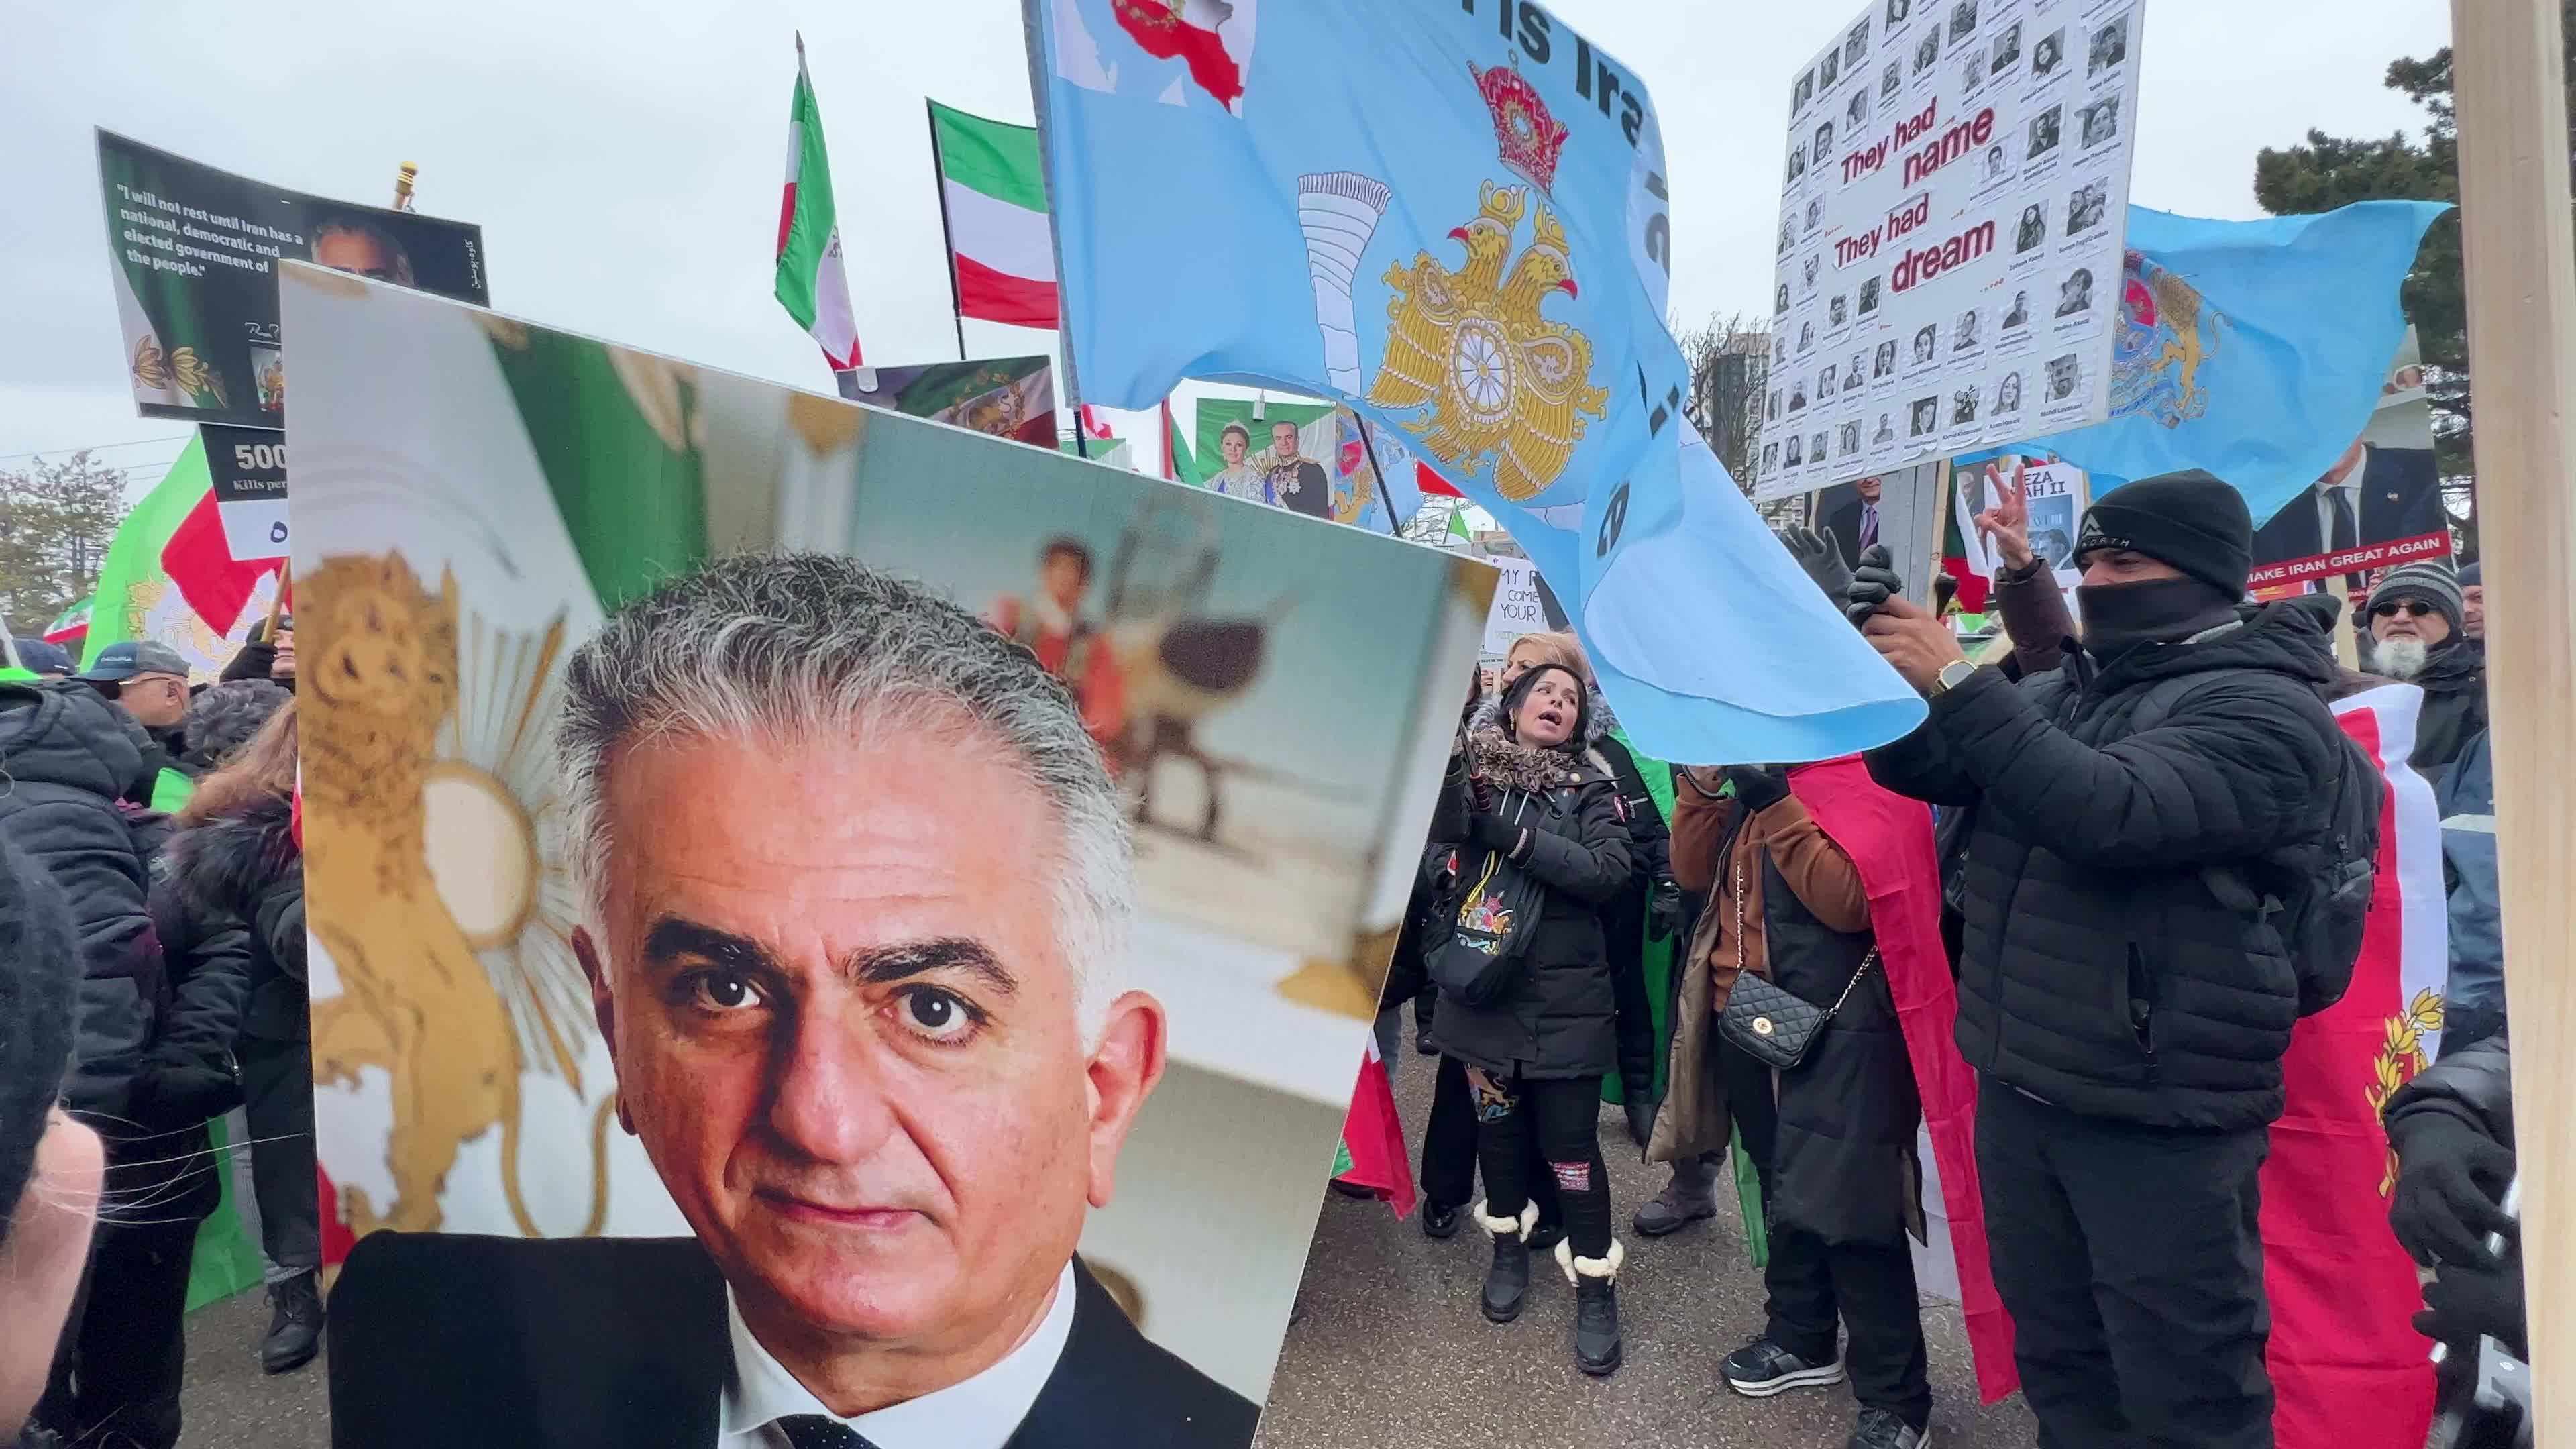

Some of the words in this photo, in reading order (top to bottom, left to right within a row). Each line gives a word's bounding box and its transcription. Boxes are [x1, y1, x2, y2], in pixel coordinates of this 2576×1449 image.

[1576, 35, 1644, 150] Ira
[1841, 135, 1890, 185] They
[1893, 95, 1937, 152] had
[1903, 107, 1995, 189] name
[117, 184, 129, 199] "I
[131, 191, 156, 207] will
[158, 198, 181, 215] not
[183, 205, 207, 221] rest
[210, 213, 239, 230] until
[241, 220, 266, 237] Iran
[269, 226, 293, 243] has
[294, 234, 304, 245] a
[120, 208, 180, 235] national,
[182, 223, 254, 252] democratic
[255, 245, 280, 258] and
[1834, 224, 1883, 268] They
[1886, 193, 1929, 242] had
[123, 229, 174, 252] elected
[175, 243, 254, 270] government
[256, 260, 269, 273] of
[127, 249, 151, 265] the
[1891, 220, 1996, 293] dream
[233, 479, 265, 490] Kills
[2247, 568, 2287, 584] MAKE
[2288, 559, 2326, 574] IRAN
[2330, 548, 2383, 567] GREAT
[2387, 537, 2441, 557] AGAIN
[1501, 604, 1535, 623] YOUR
[1508, 590, 1538, 603] COME
